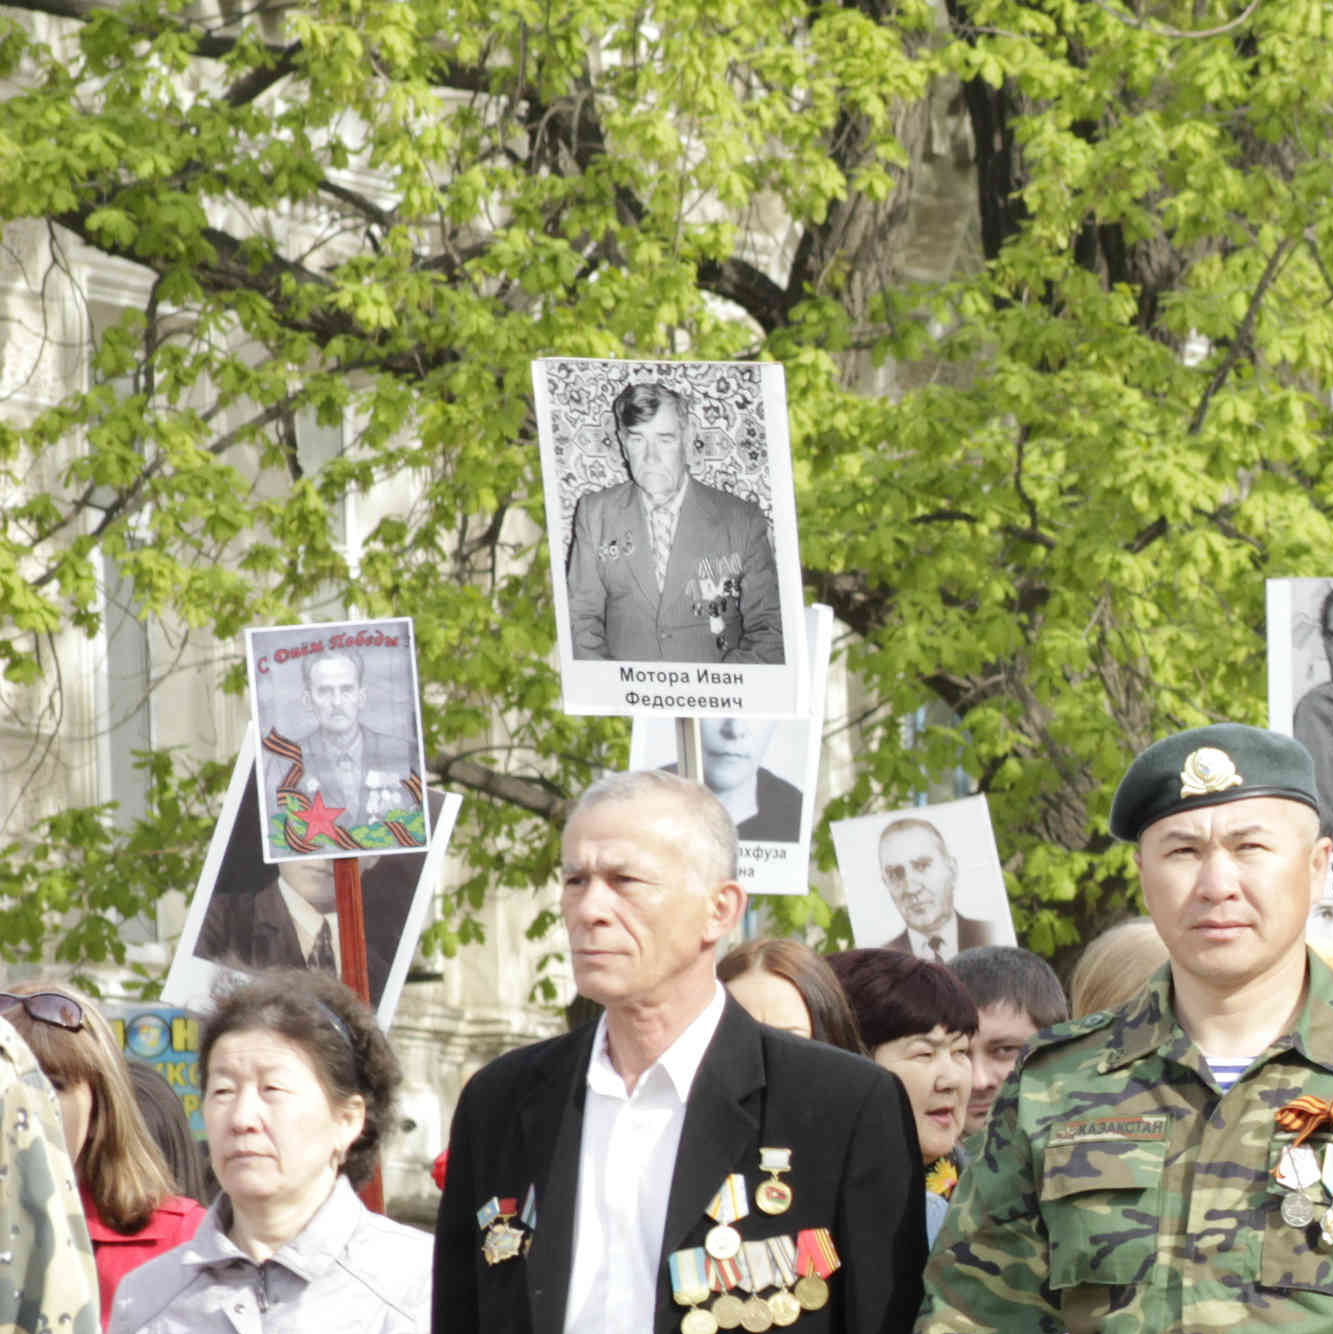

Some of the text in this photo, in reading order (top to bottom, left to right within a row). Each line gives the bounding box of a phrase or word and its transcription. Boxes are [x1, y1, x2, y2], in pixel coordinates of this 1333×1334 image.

[328, 630, 401, 651] Победы
[620, 667, 744, 686] Мотора Иван
[625, 691, 743, 708] Федосеевич
